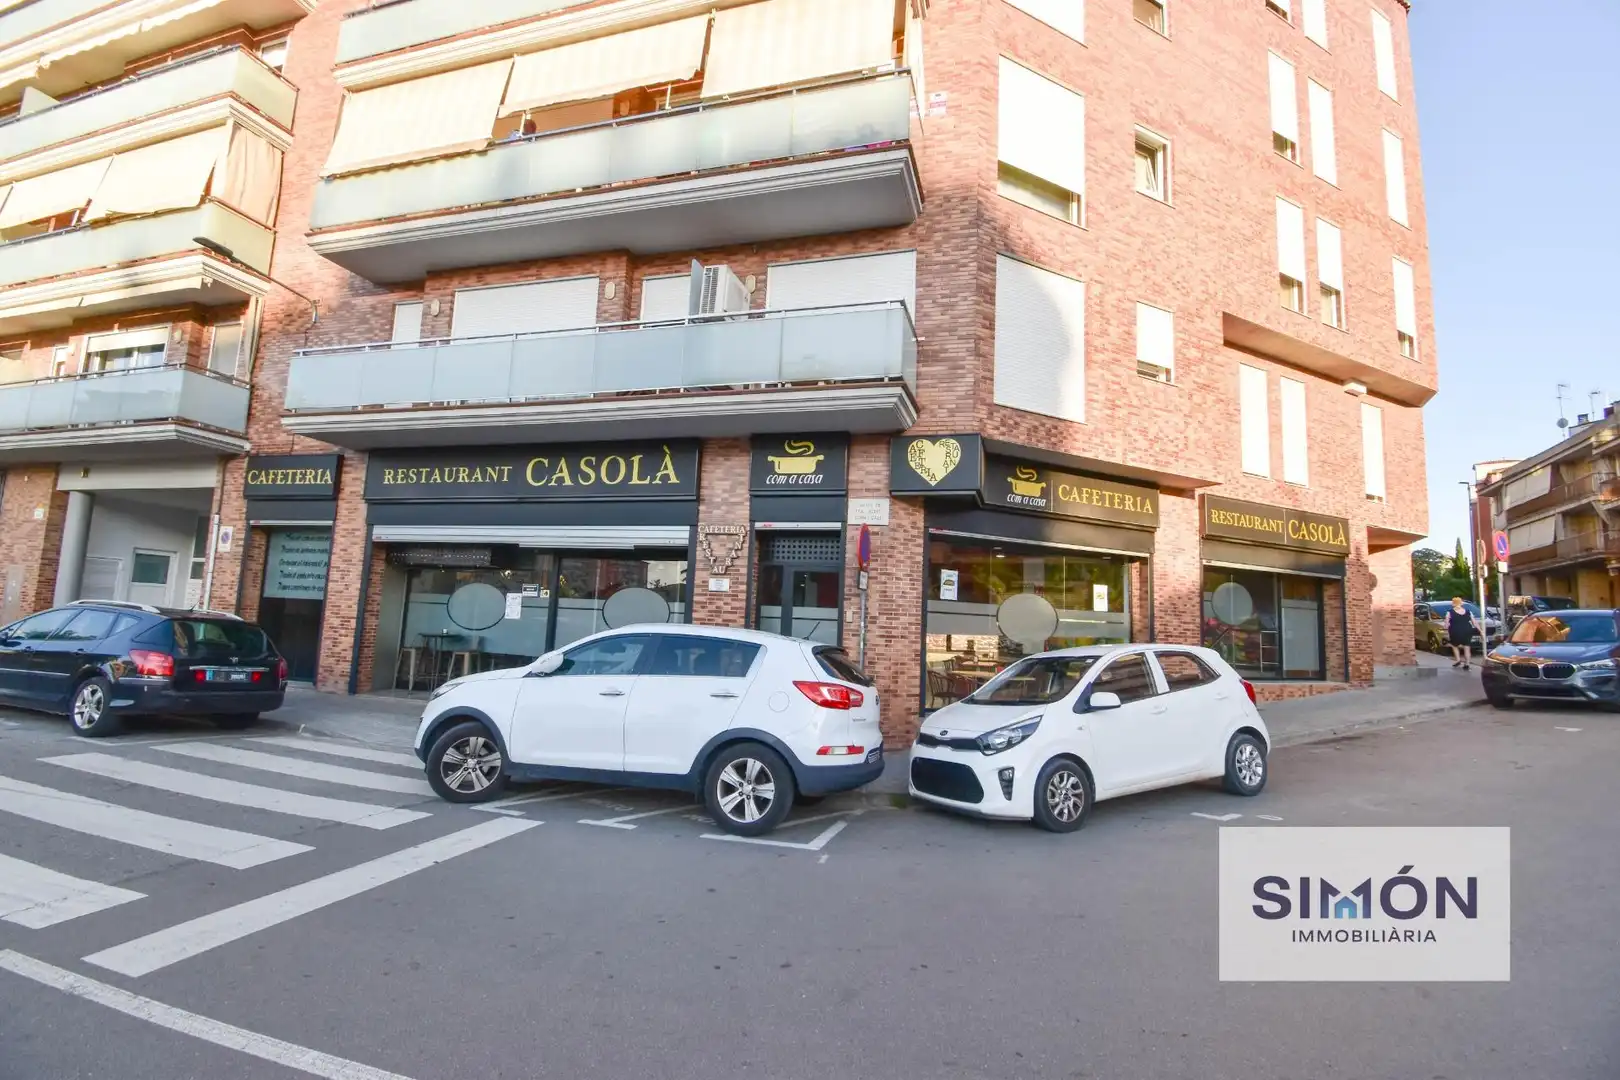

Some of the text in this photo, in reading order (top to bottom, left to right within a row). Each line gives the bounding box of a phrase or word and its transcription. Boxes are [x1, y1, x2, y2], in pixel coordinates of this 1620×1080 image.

[383, 444, 681, 487] RESTAURANT CASOLÀ
[247, 468, 333, 485] CAFETERIA
[766, 473, 824, 485] com a casa
[1006, 493, 1047, 507] com a casa
[1058, 484, 1154, 514] CAFETERIA
[698, 524, 746, 534] CAFETERIA
[1210, 509, 1347, 546] RESTAURANT CASOLÀ
